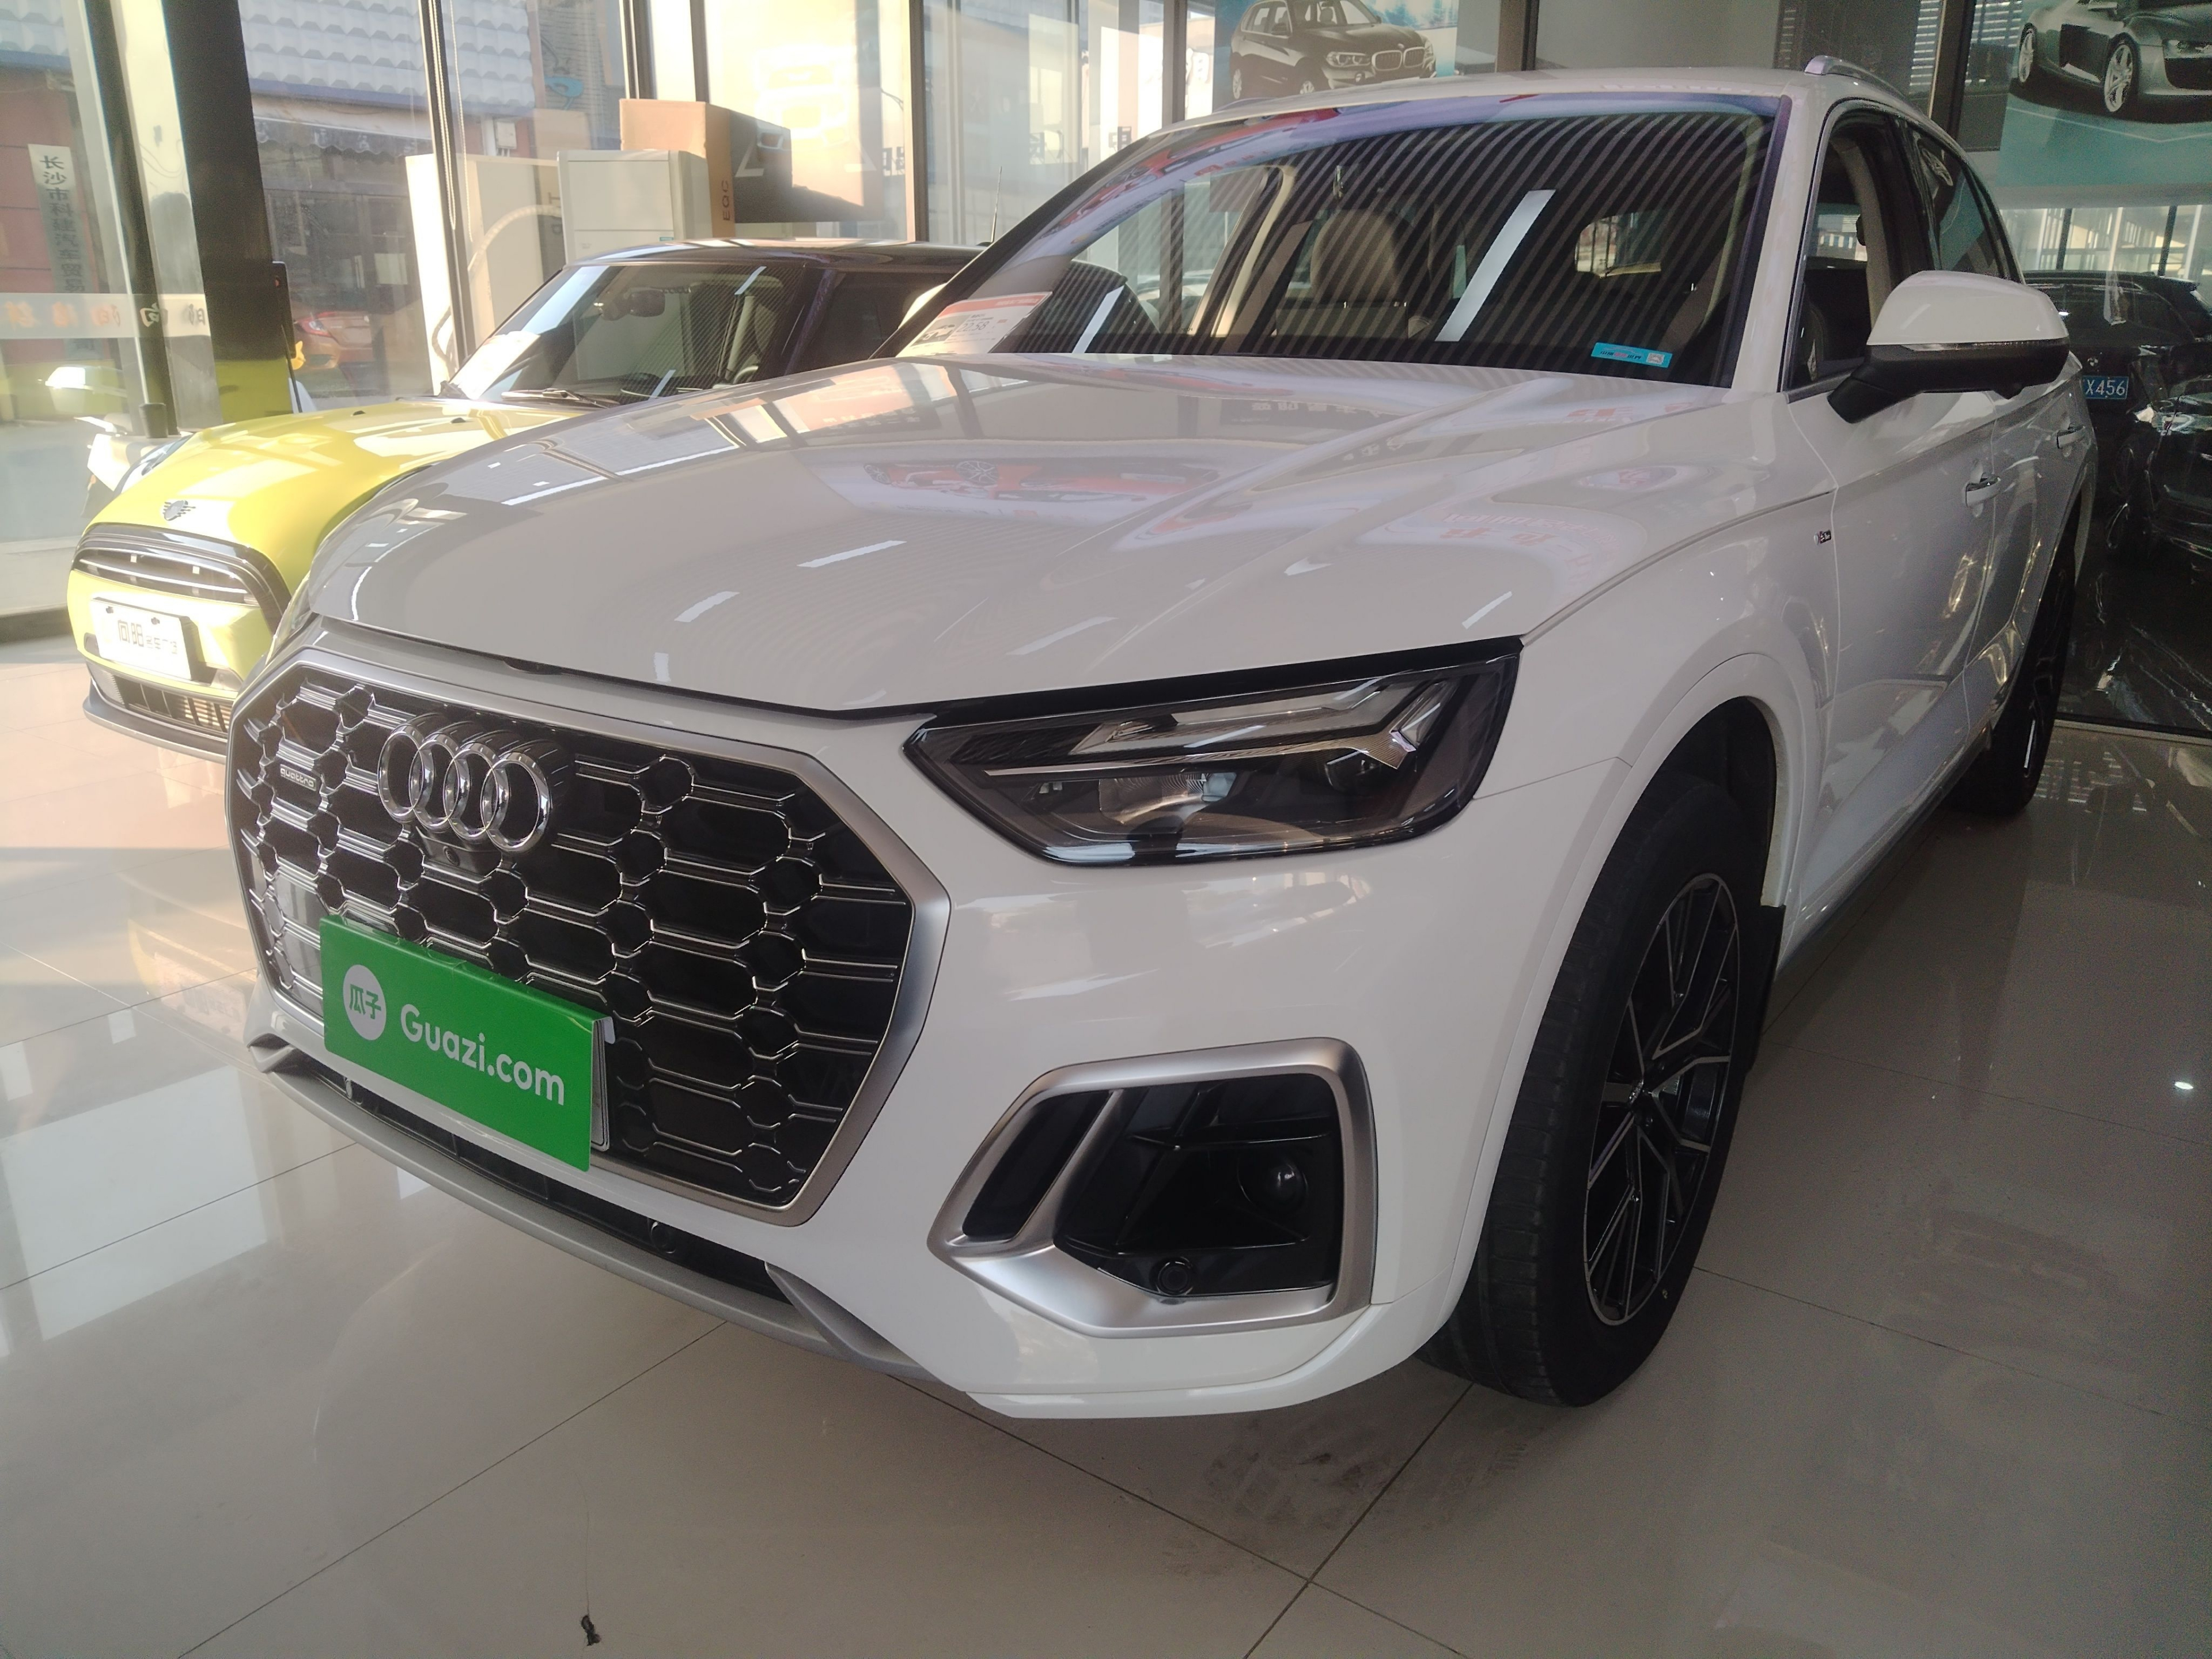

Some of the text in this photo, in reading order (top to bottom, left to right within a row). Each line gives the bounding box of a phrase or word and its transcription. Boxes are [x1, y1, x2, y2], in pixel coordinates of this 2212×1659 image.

[956, 320, 990, 333] 22.58
[2085, 379, 2125, 395] X456
[280, 768, 314, 787] quattro
[349, 984, 381, 1020] 瓜子
[401, 1004, 565, 1105] Guazi.com
